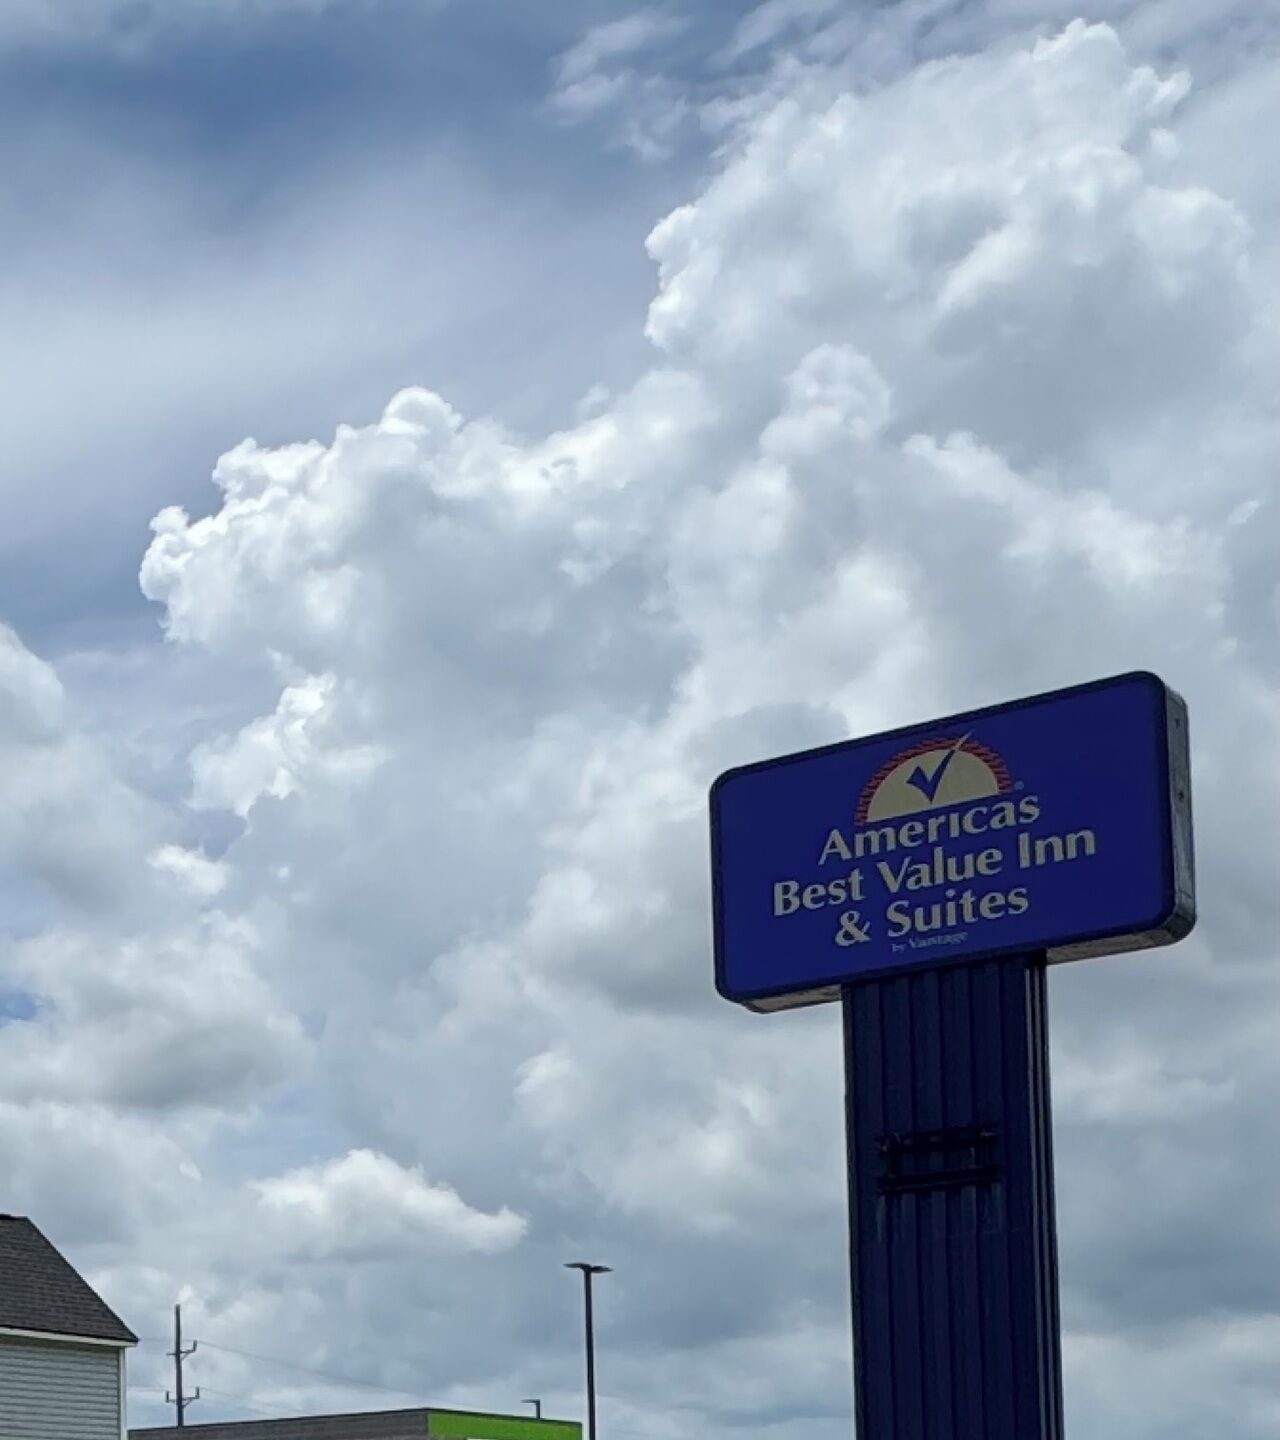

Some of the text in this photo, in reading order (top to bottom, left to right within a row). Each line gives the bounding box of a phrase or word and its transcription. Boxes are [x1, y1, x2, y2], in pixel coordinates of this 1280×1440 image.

[819, 794, 1040, 865] Americas
[774, 828, 1096, 916] Best Value Inn
[835, 887, 1029, 946] & Suites
